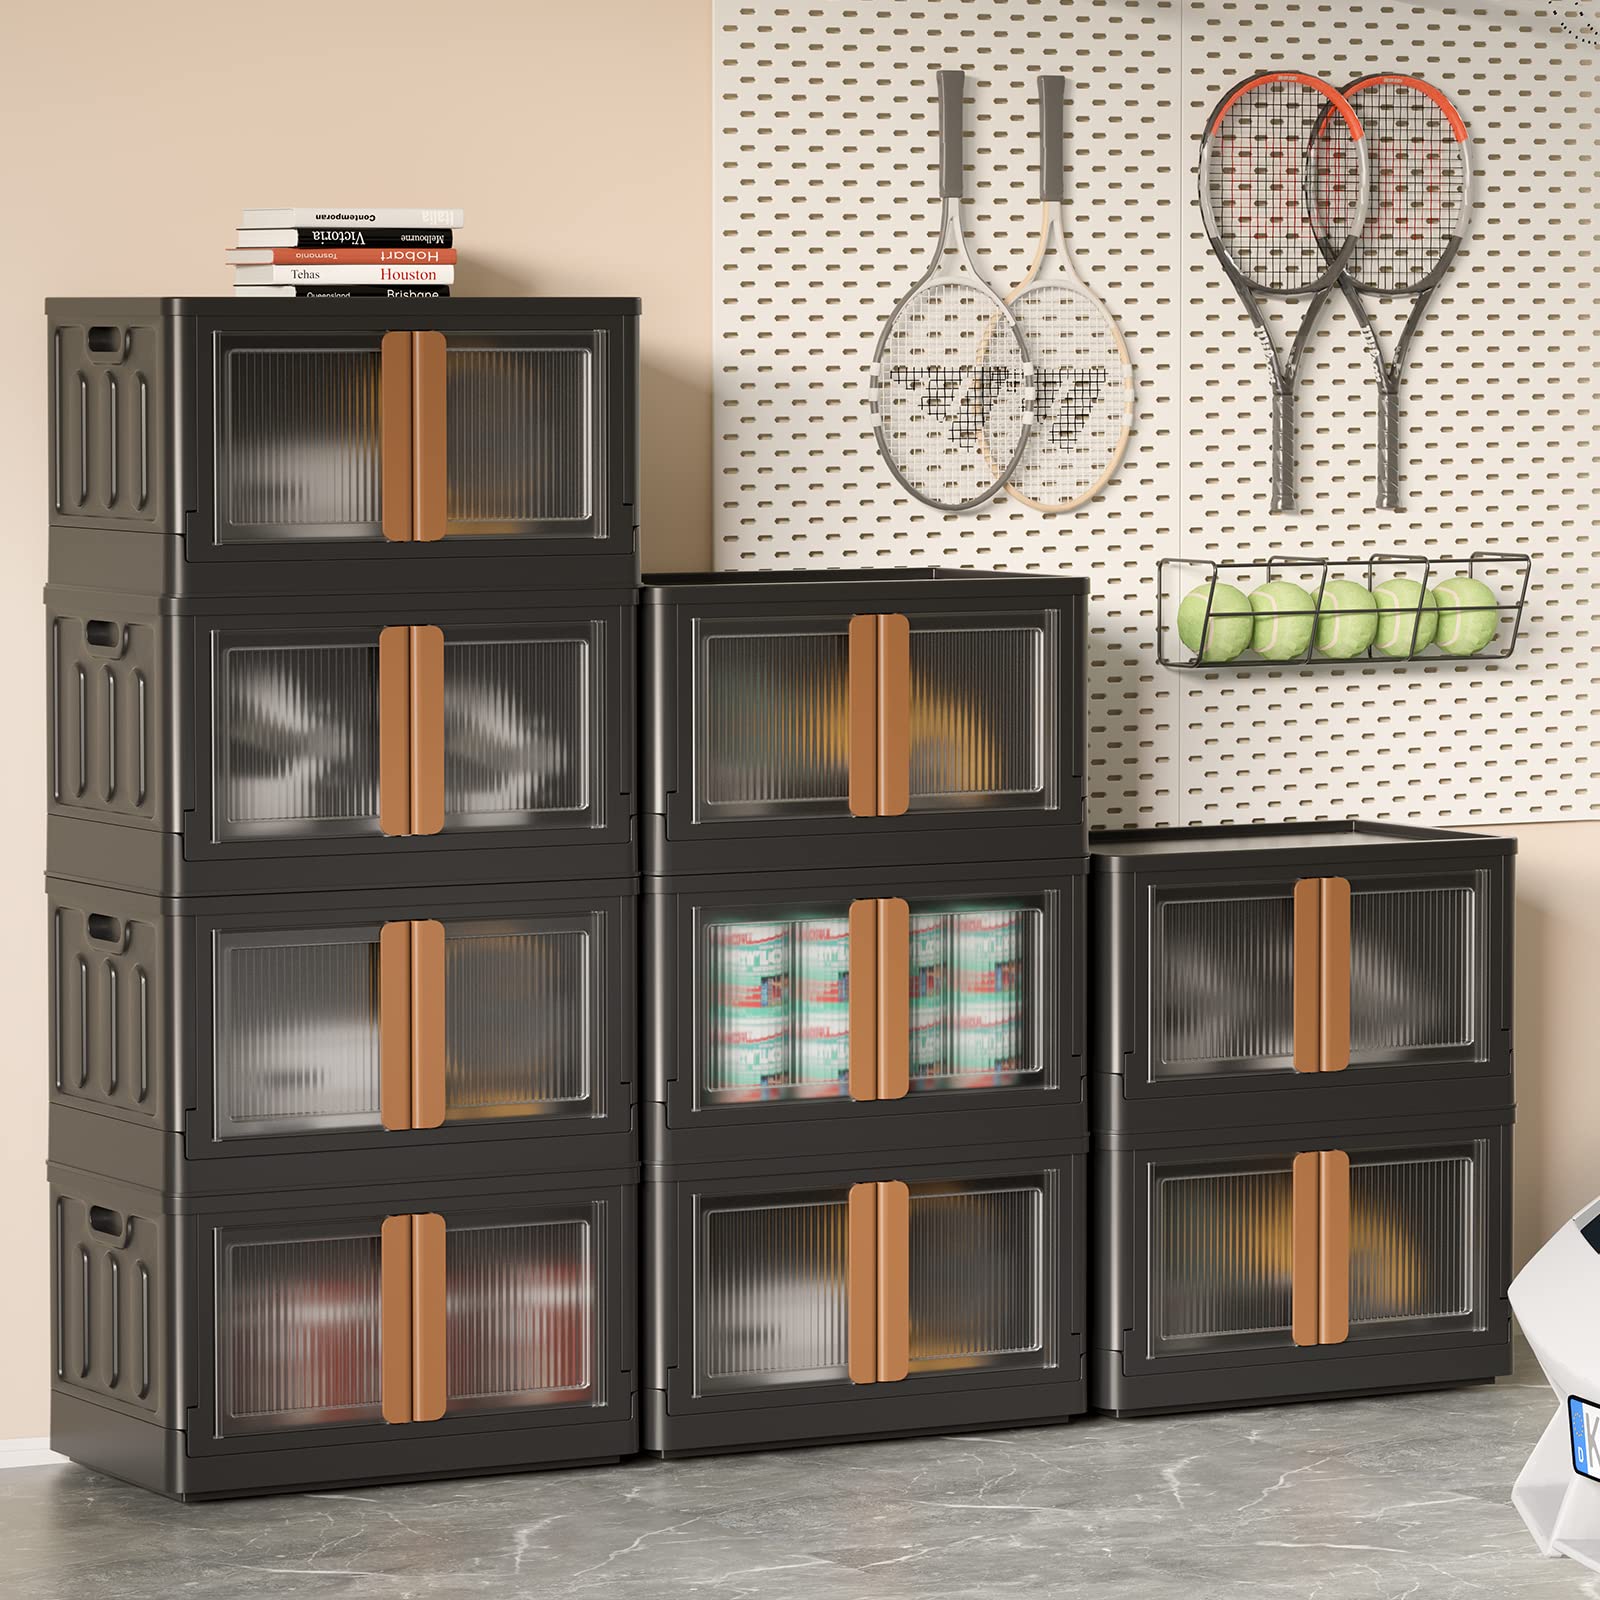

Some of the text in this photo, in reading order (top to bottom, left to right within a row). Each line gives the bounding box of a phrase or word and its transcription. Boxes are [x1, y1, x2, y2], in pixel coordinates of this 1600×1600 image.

[315, 213, 376, 222] Contemporan
[312, 230, 445, 246] Melbourne Victoria
[295, 251, 439, 262] Hobart Tasmania
[291, 268, 437, 281] Tehas Houston
[386, 289, 439, 297] Brisbane
[1578, 1446, 1584, 1463] D
